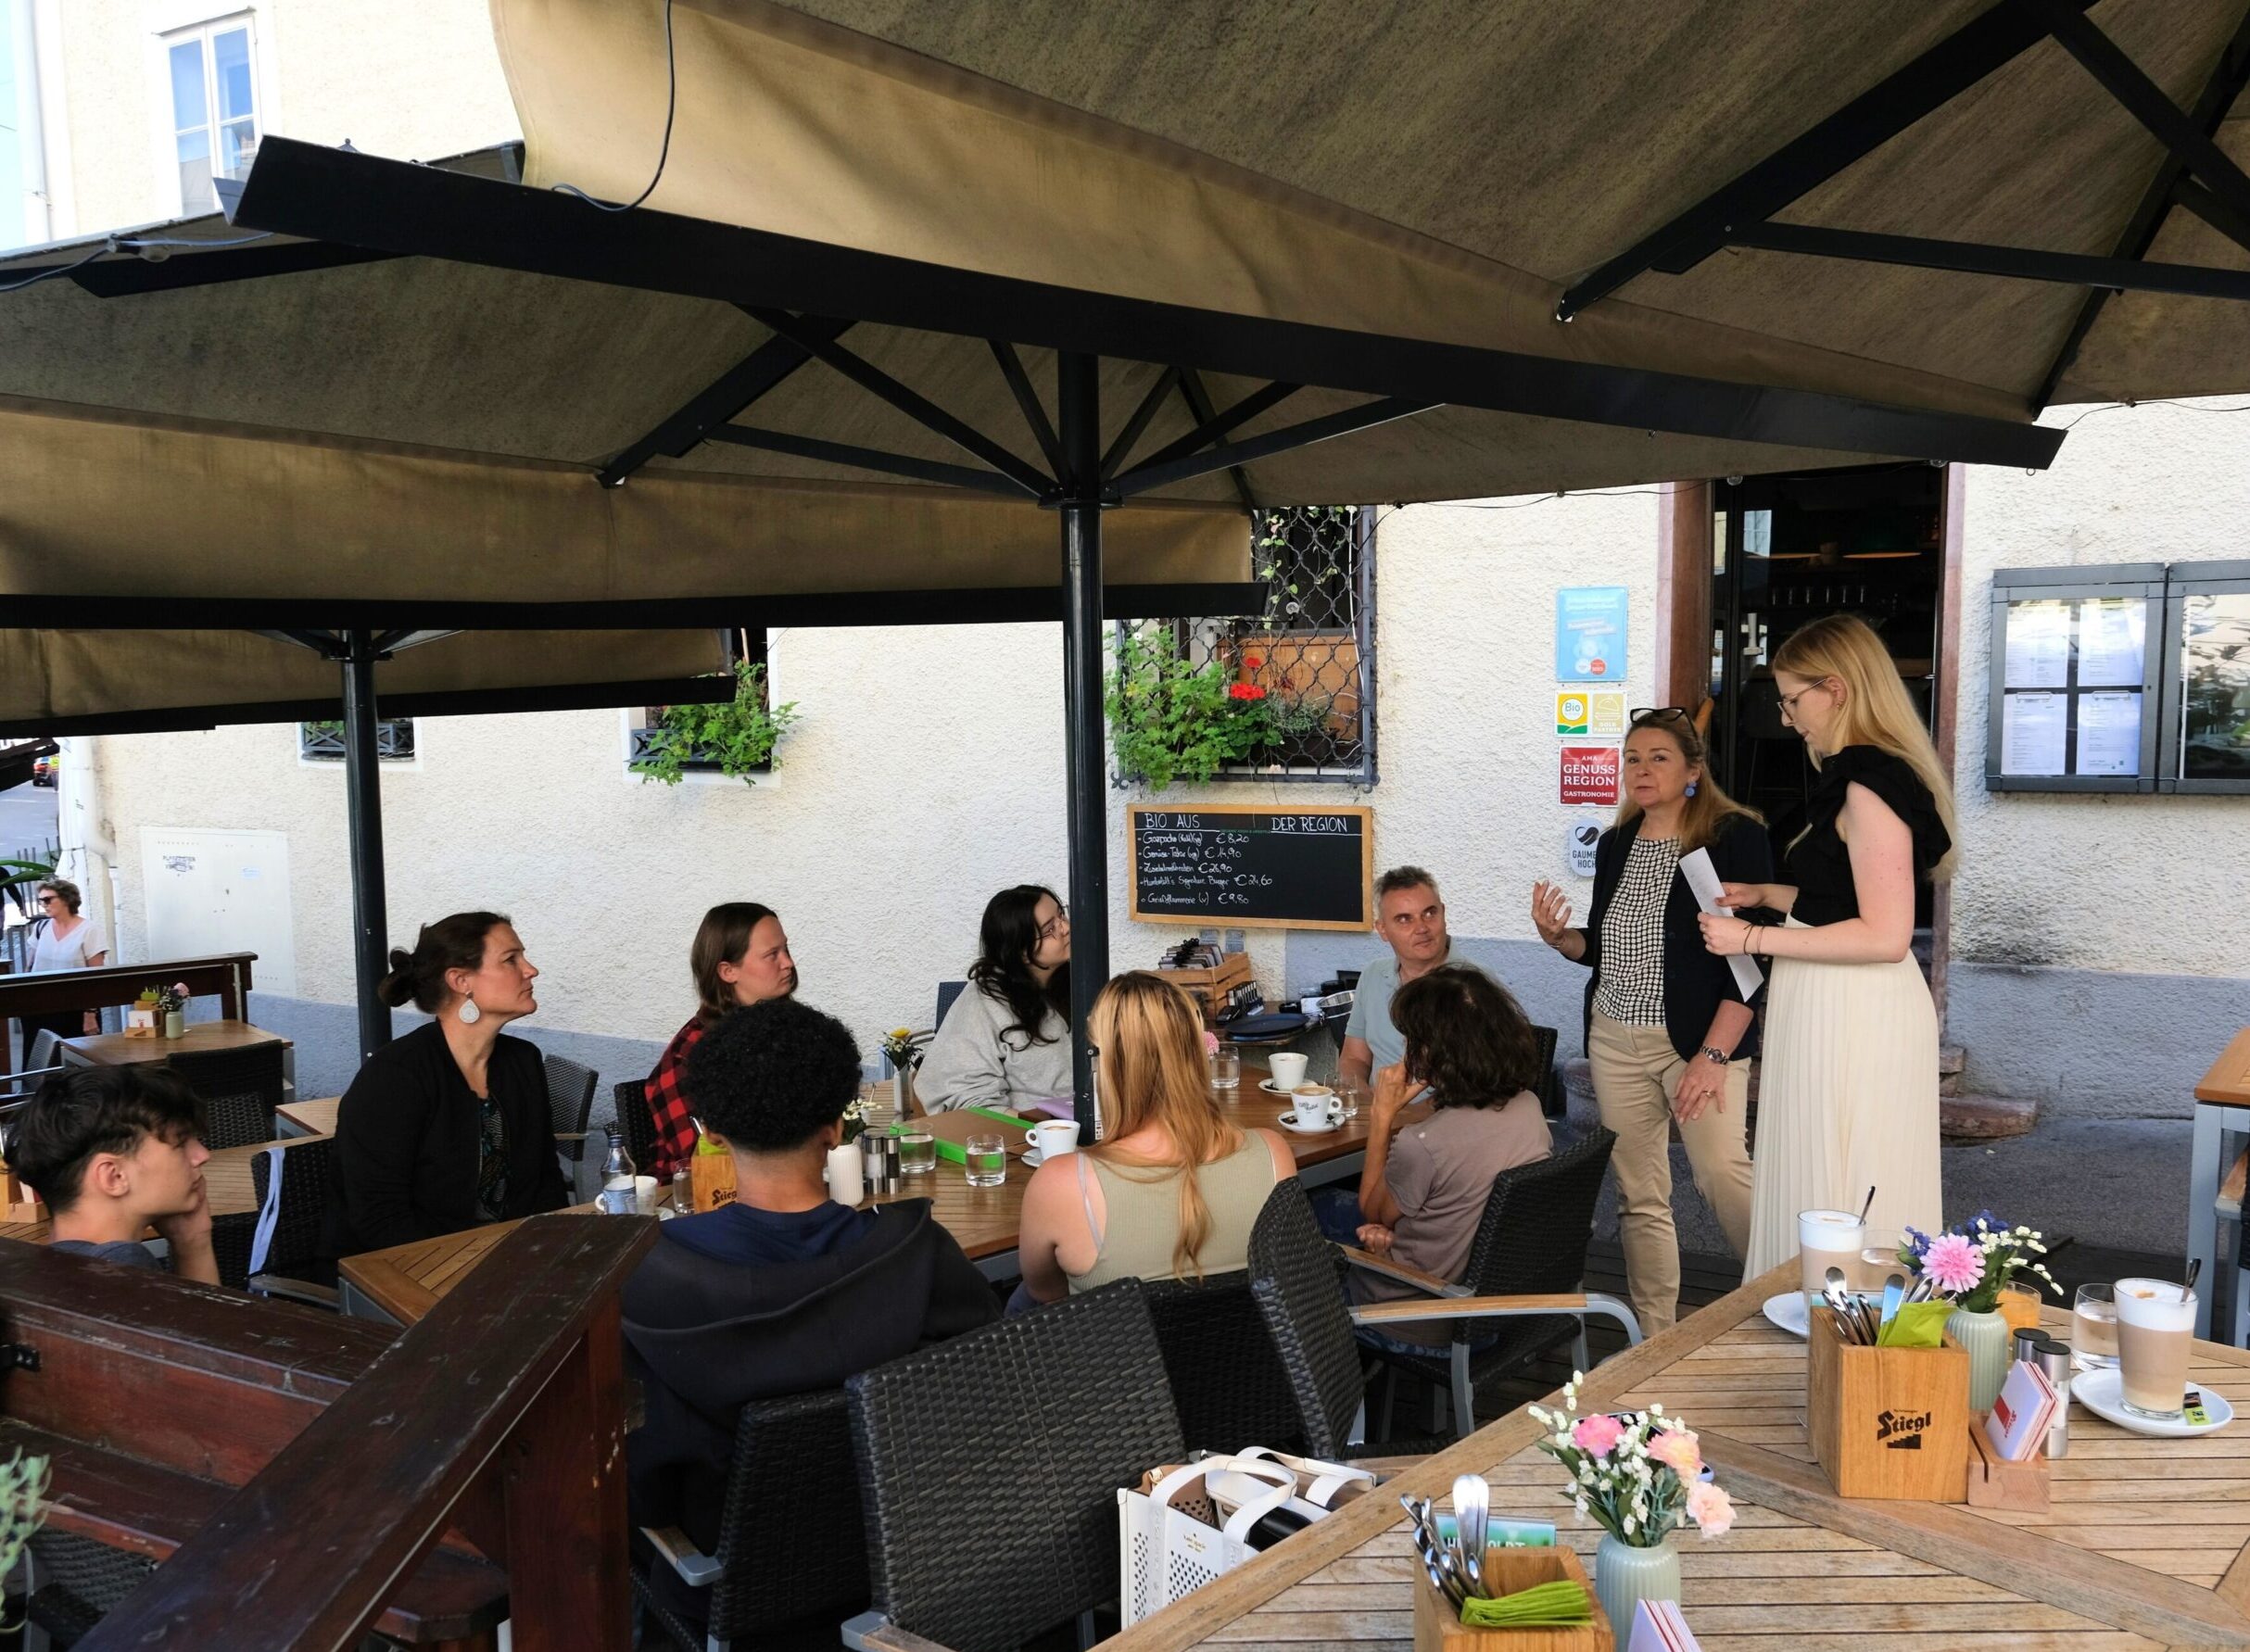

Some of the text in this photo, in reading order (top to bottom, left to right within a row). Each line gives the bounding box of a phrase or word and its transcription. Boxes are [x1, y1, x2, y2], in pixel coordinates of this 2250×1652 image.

[1564, 701, 1581, 713] Bio
[1562, 763, 1616, 775] GENUSS
[1563, 776, 1615, 787] REGION
[1144, 813, 1347, 832] BIO AUS DER REGION
[1572, 850, 1597, 860] GAUME
[711, 1189, 738, 1205] Stieg
[1877, 1409, 1931, 1441] Stiegl
